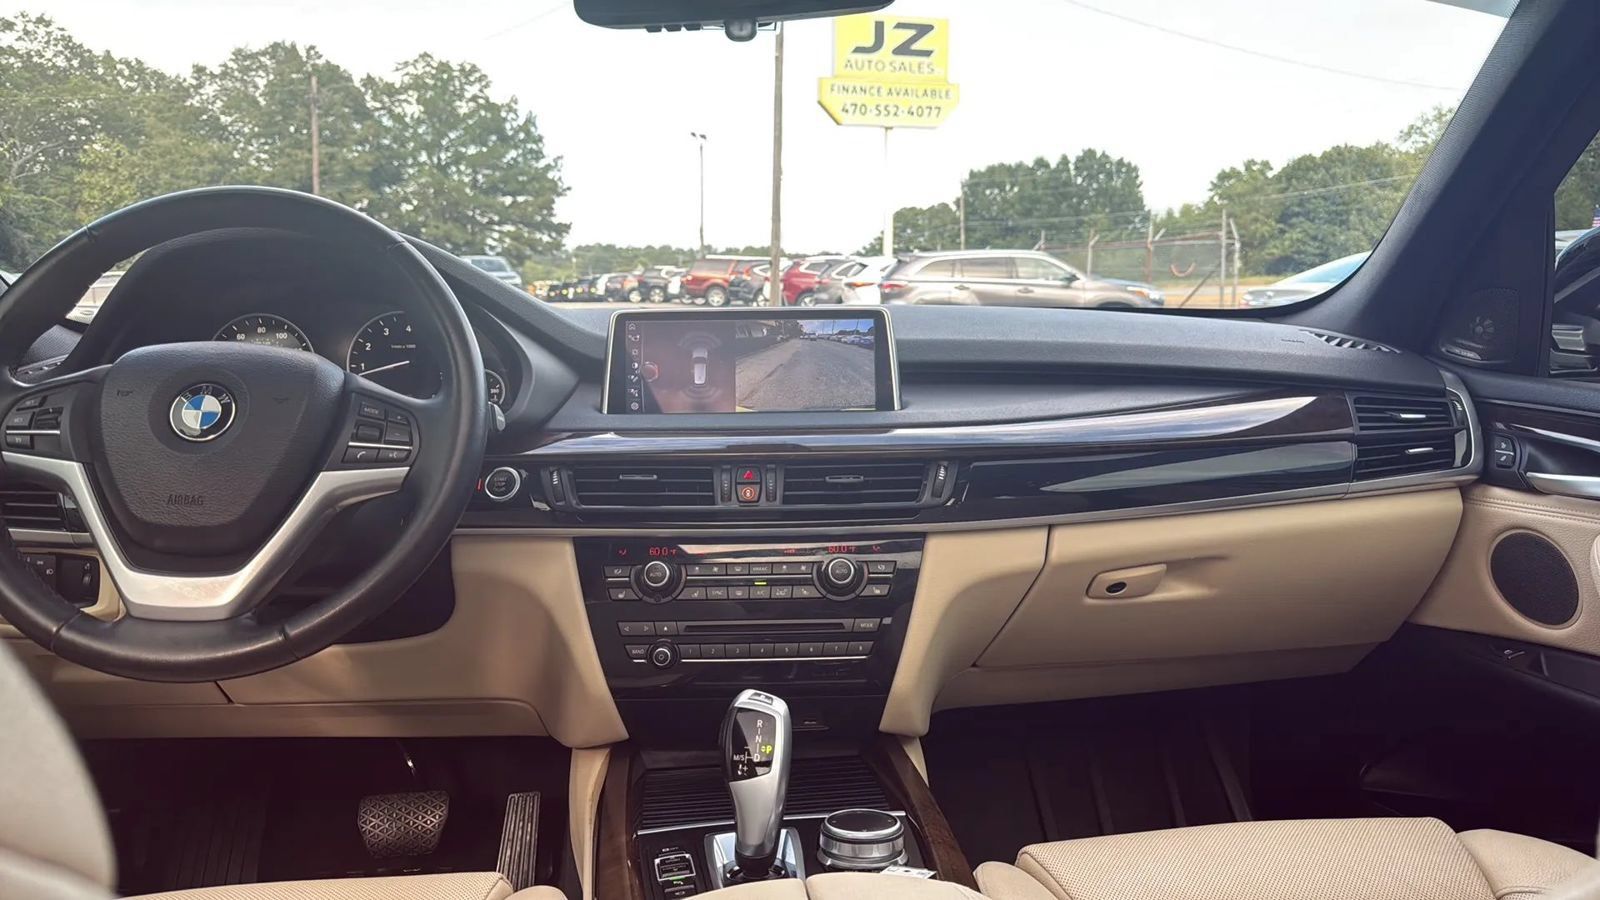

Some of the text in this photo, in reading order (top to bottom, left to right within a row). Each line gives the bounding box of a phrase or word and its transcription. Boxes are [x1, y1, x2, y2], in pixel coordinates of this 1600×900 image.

[851, 20, 935, 58] JZ
[844, 58, 935, 75] AUTO SALES
[829, 83, 952, 100] FINANCE AVAILABLE
[275, 332, 288, 340] 100
[383, 328, 390, 336] 3
[365, 342, 371, 351] 2
[360, 363, 365, 371] 1
[180, 386, 231, 404] BMW
[166, 493, 204, 506] AIRBAG
[757, 719, 763, 728] R
[755, 735, 762, 743] N
[766, 745, 773, 754] P
[753, 753, 760, 762] D
